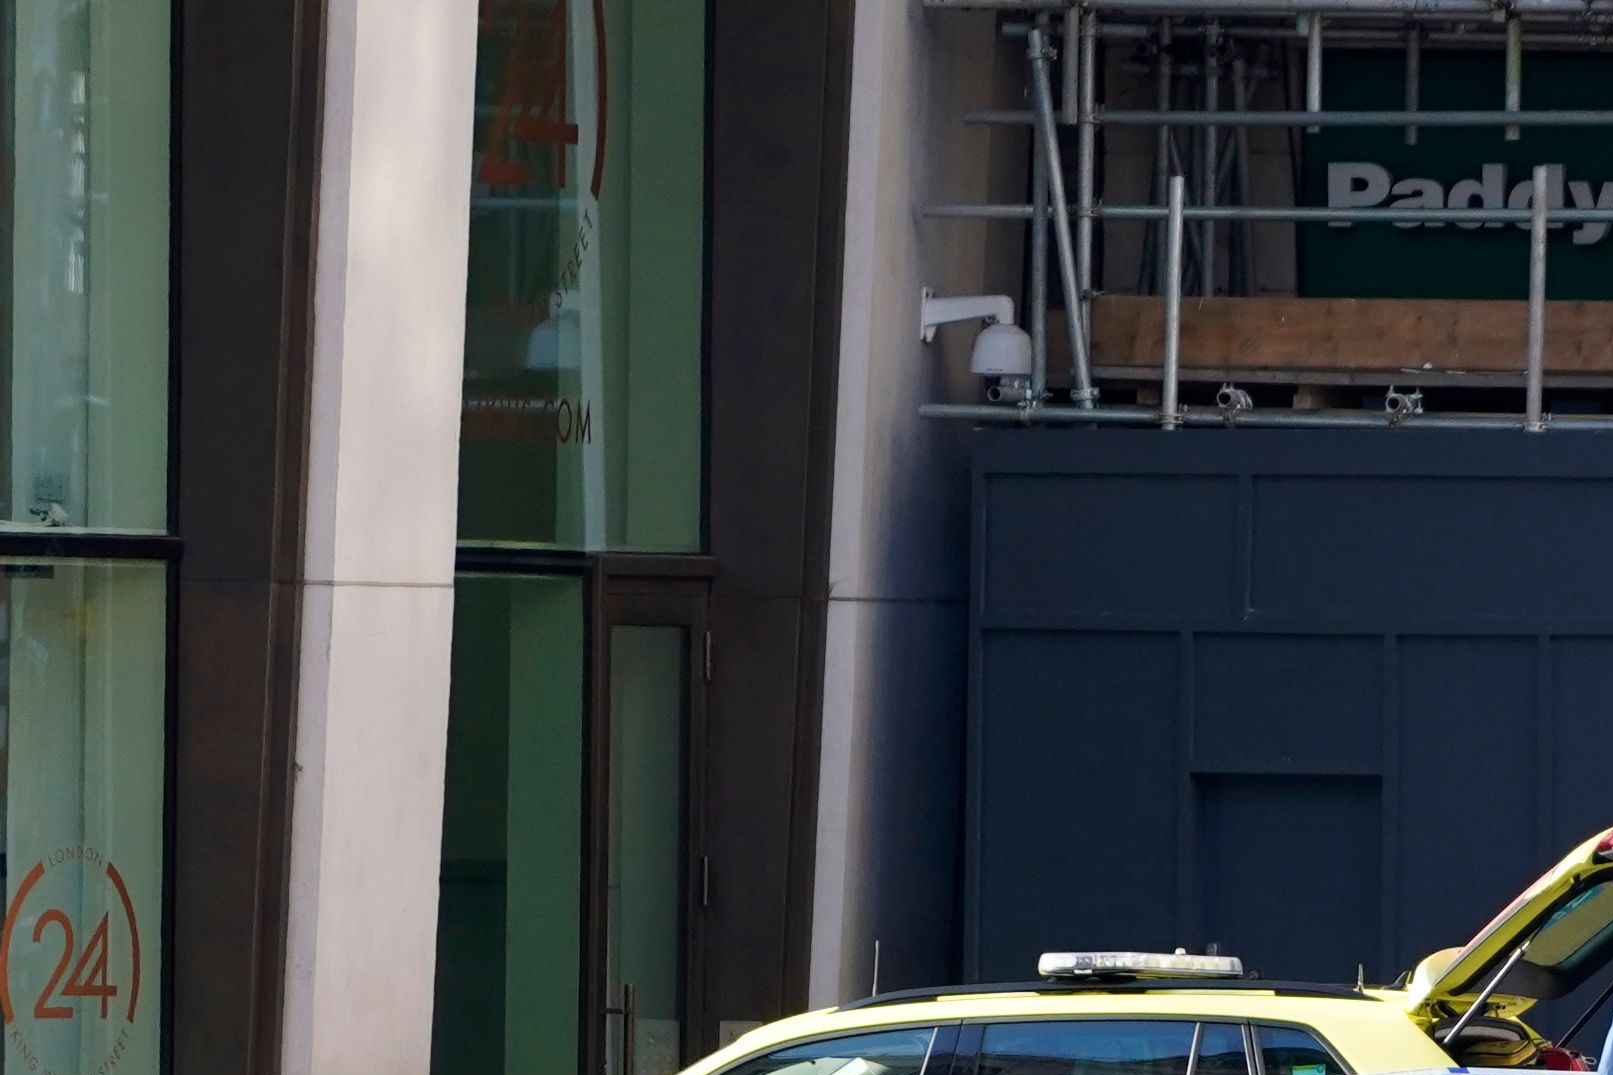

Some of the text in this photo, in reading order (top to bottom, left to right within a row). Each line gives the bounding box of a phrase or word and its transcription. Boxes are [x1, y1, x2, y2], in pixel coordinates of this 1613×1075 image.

[48, 847, 105, 867] LONDON
[31, 908, 118, 1020] 24
[10, 1029, 39, 1071] KING
